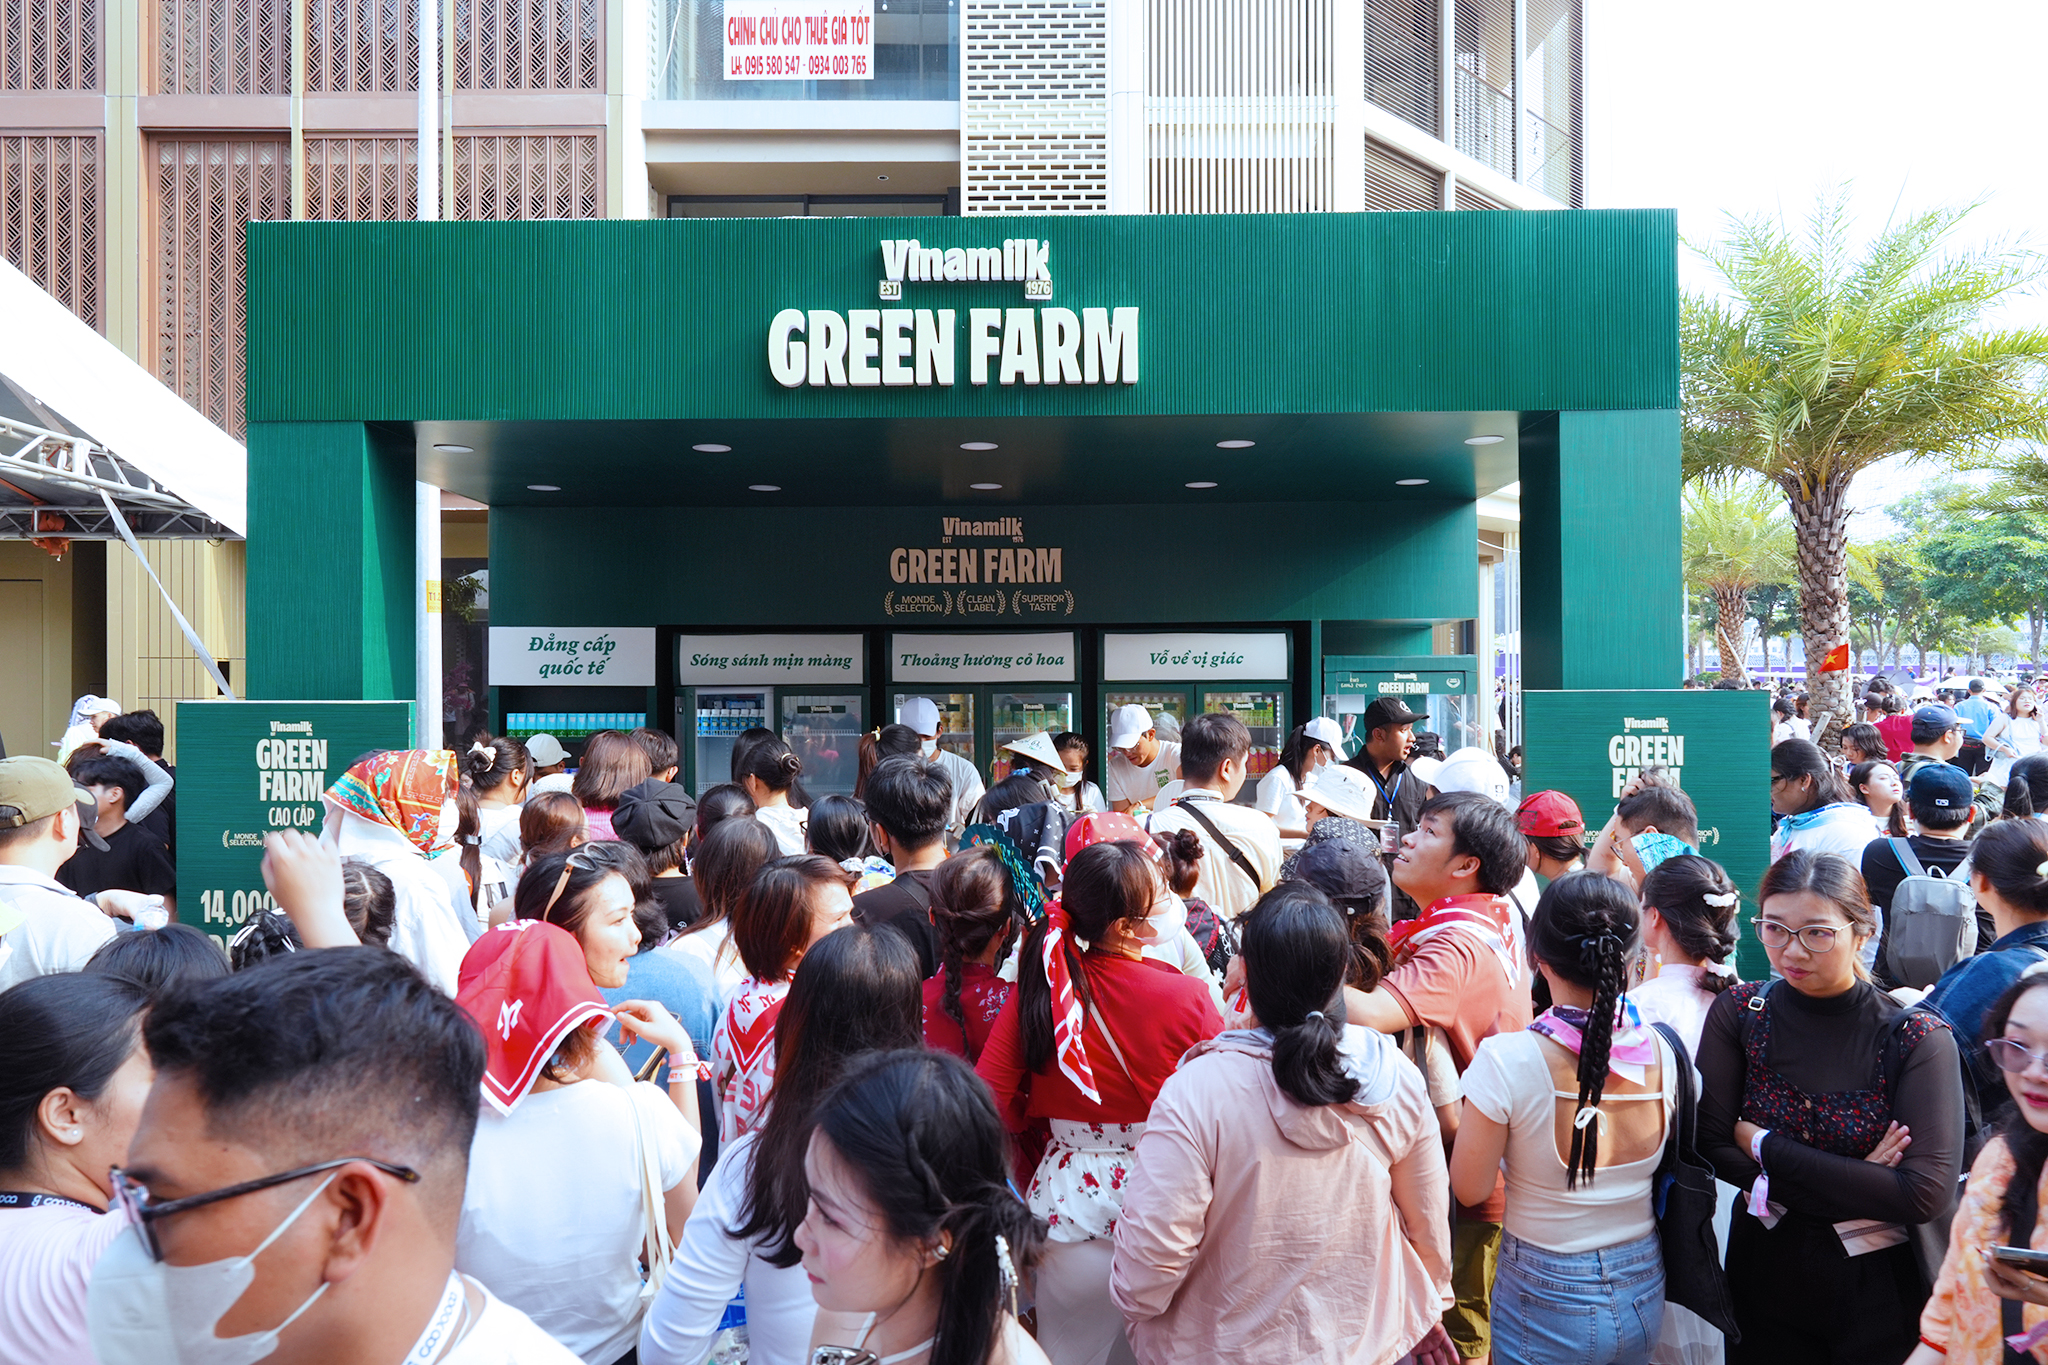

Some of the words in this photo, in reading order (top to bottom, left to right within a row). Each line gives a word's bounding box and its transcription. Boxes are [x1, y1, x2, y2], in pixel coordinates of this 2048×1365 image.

[727, 10, 756, 45] CHÍNH
[760, 7, 778, 45] CHỦ
[782, 16, 802, 45] CHO
[805, 9, 828, 45] THUÊ
[831, 9, 848, 45] GIÁ
[850, 5, 870, 45] TỐT
[731, 56, 742, 75] LH:
[745, 55, 764, 75] 0915
[766, 55, 782, 75] 580
[785, 55, 800, 75] 547
[808, 55, 830, 75] 0934
[833, 55, 849, 75] 003
[852, 55, 867, 75] 765
[880, 238, 1051, 282] Vinamilk
[880, 281, 899, 296] EST
[1026, 280, 1051, 296] 1976
[767, 308, 956, 387] GREEN
[970, 307, 1140, 385] FARM
[942, 517, 1023, 536] Vinamilk
[890, 548, 978, 584] GREEN
[984, 548, 1062, 583] FARM
[901, 596, 935, 604] MONDE
[966, 595, 995, 603] CLEAN
[1021, 594, 1065, 603] SUPERIOR
[1029, 603, 1057, 611] TASTE
[894, 604, 942, 613] SELECTION
[968, 604, 996, 612] LABEL
[528, 633, 580, 655] Đẳng
[583, 633, 616, 655] cấp
[690, 653, 729, 669] Sóng
[731, 653, 769, 666] sánh
[772, 653, 803, 670] mịn
[807, 654, 852, 669] màng
[900, 653, 960, 669] Thoảng
[963, 653, 1013, 669] hương
[1015, 653, 1033, 666] cỏ
[1036, 653, 1065, 666] hoa
[1150, 649, 1170, 665] Vỗ
[1171, 650, 1191, 664] về
[1192, 651, 1208, 668] vị
[1209, 651, 1244, 668] giác
[539, 657, 583, 678] quốc
[587, 657, 611, 675] tế
[1378, 682, 1404, 693] GREEN
[1406, 682, 1430, 693] FARM
[270, 721, 313, 732] Vinamilk
[1624, 717, 1669, 729] Vinamilk
[256, 738, 328, 770] GREEN
[1608, 735, 1684, 767] GREEN
[259, 771, 325, 801] FARM
[268, 807, 291, 827] CAO
[293, 803, 316, 827] CẤP
[229, 839, 263, 847] SELECTION
